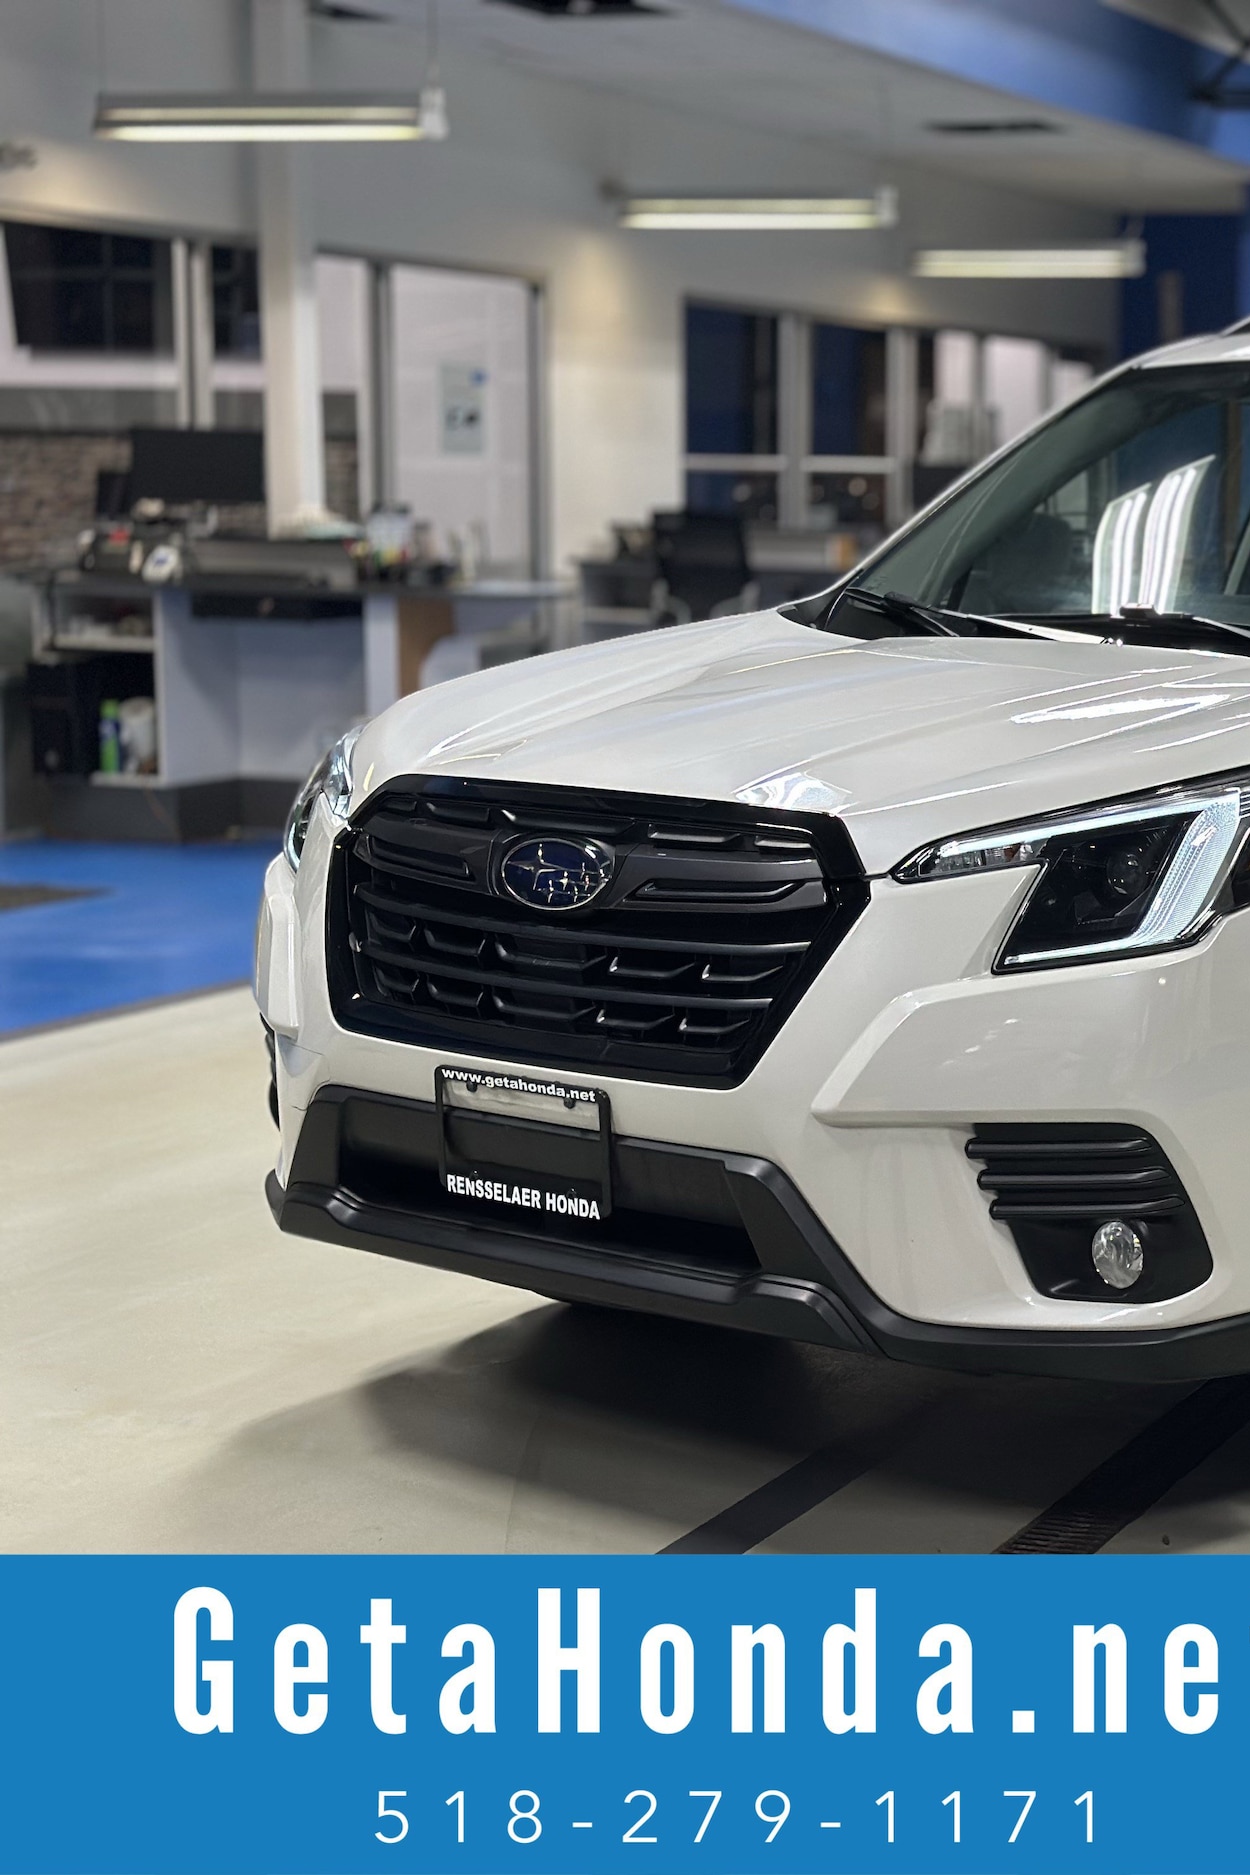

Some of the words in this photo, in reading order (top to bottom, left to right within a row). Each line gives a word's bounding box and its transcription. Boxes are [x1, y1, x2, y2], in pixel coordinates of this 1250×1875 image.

[441, 1068, 596, 1102] www.getahonda.net
[446, 1174, 541, 1209] RENSSELAER
[545, 1192, 600, 1220] HONDA
